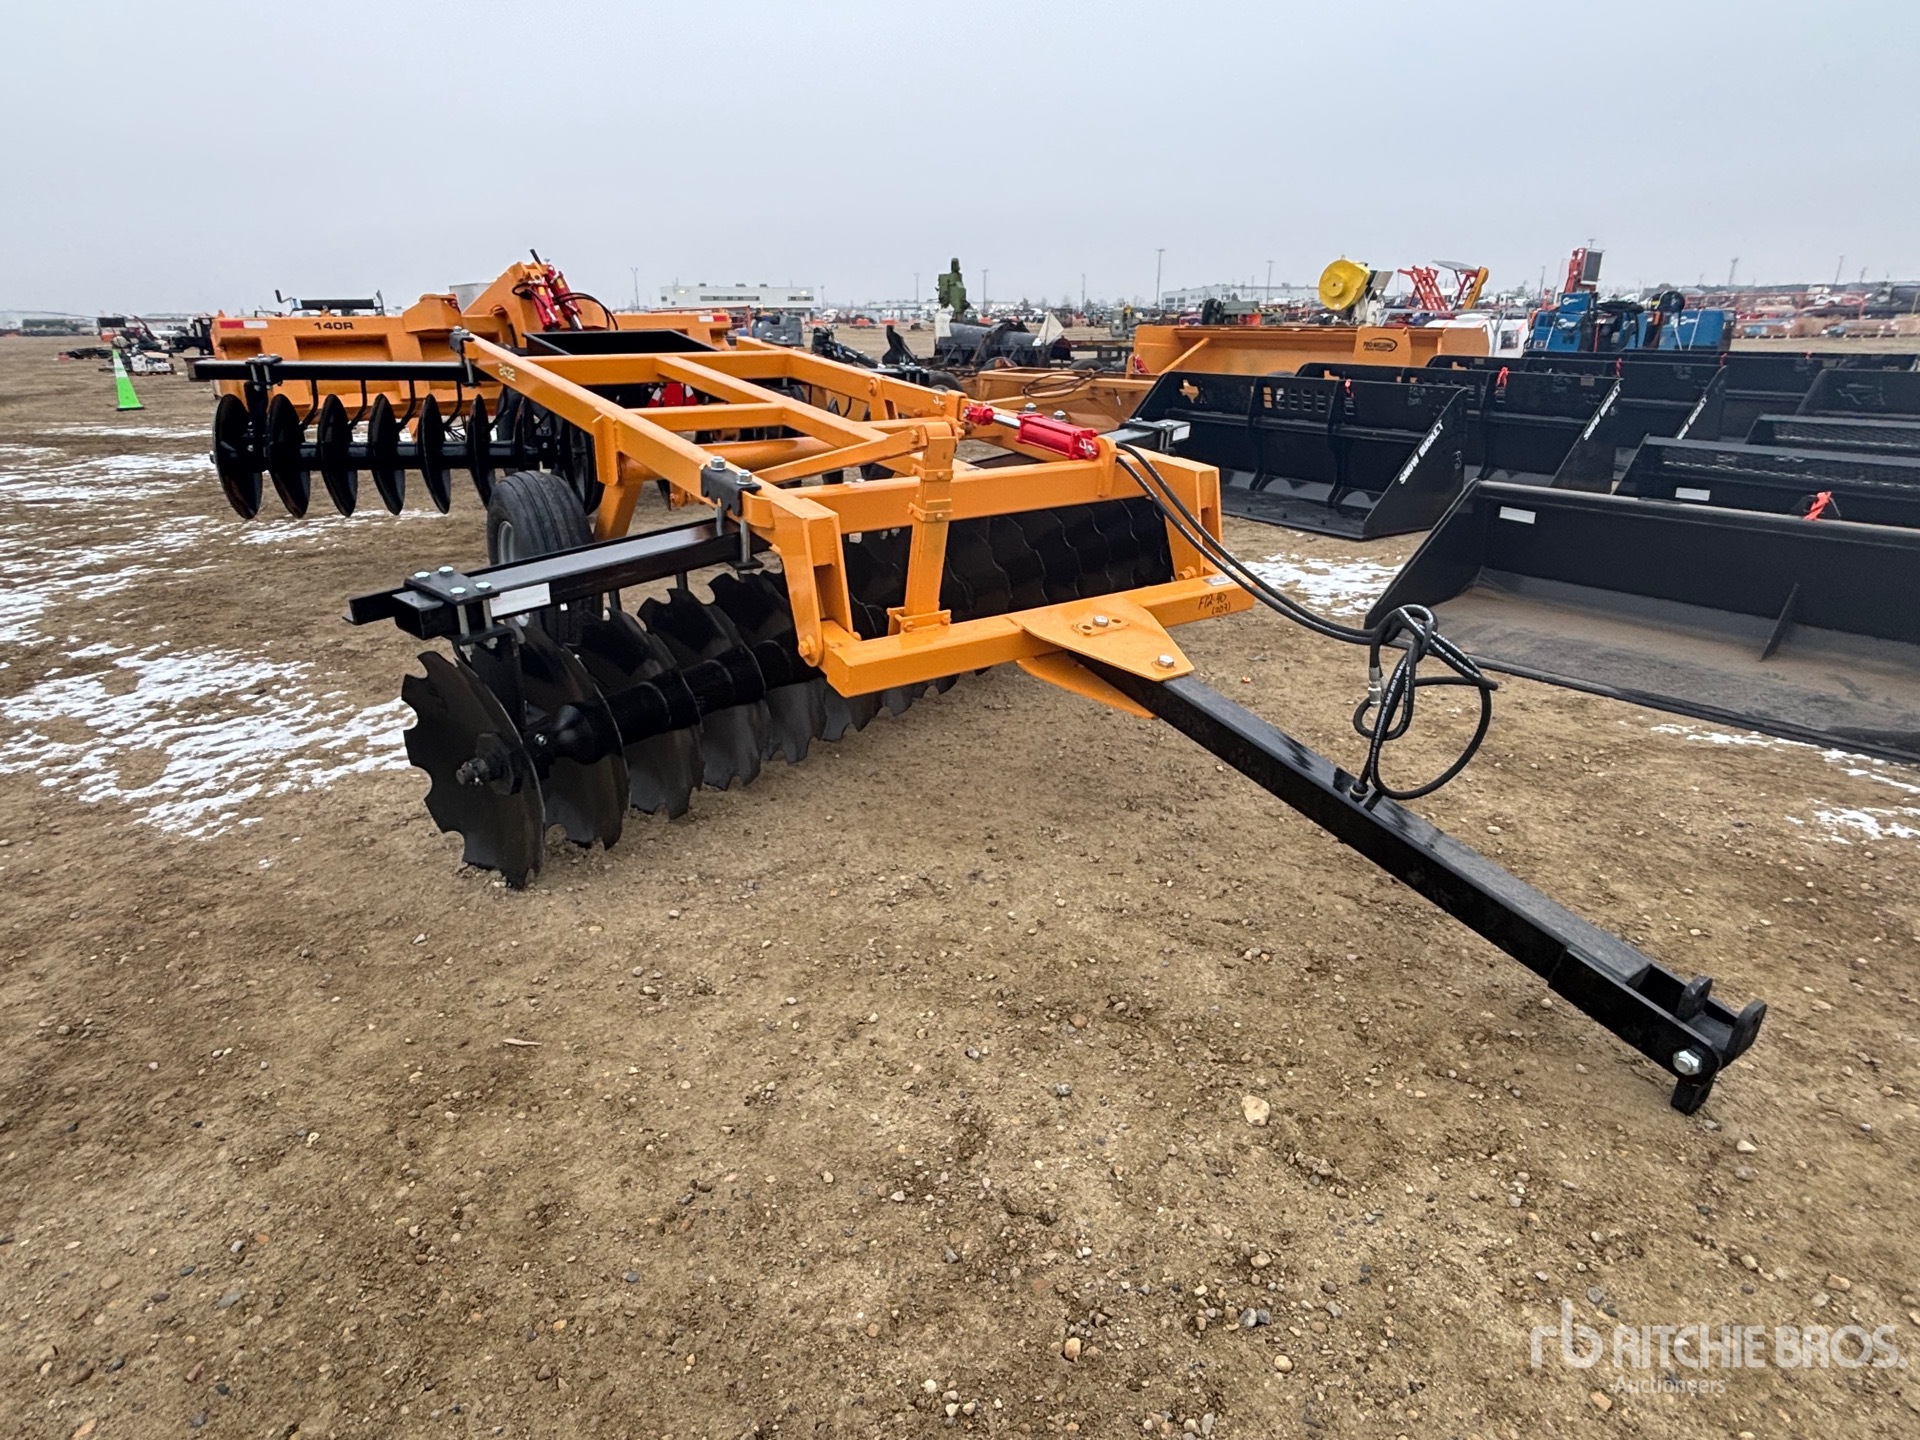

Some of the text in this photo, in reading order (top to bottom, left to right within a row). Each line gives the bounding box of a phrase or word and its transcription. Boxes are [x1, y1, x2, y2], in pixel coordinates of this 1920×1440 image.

[313, 321, 354, 331] 140R
[1398, 419, 1444, 485] SNOW BUCKET
